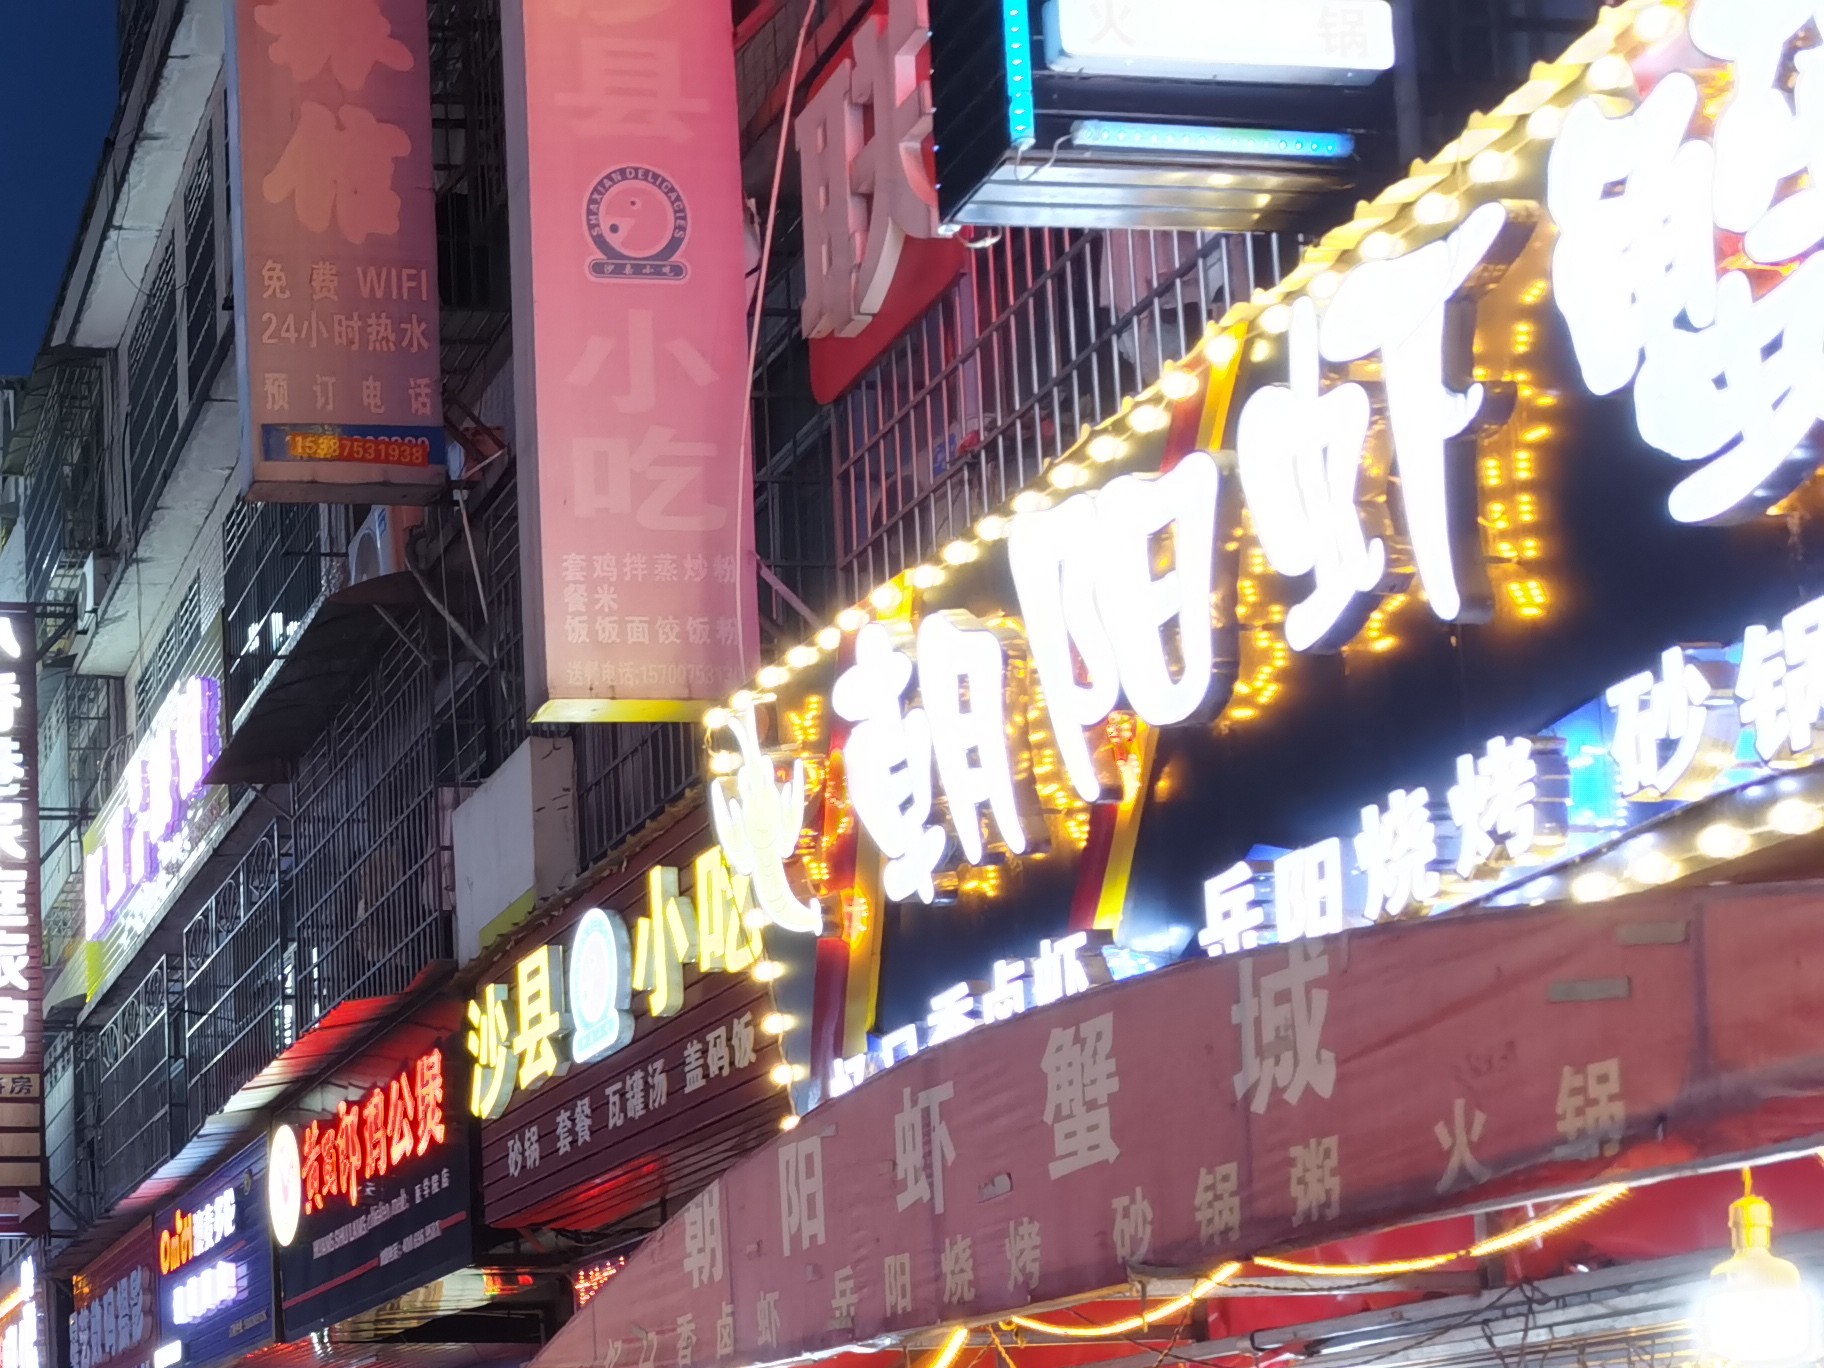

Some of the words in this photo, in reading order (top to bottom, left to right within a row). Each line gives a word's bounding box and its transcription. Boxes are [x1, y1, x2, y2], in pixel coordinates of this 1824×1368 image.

[262, 259, 339, 301] 免费
[356, 266, 427, 301] WIFI
[262, 310, 430, 353] 24小时热水
[264, 373, 431, 416] 预订电话
[565, 309, 731, 533] 小吃
[1198, 735, 1537, 957] 岳阳烧烤
[467, 944, 561, 1120] 沙县
[507, 1125, 540, 1177] 砂锅
[556, 1096, 592, 1155] 套餐
[604, 1058, 668, 1131] 瓦罐汤
[683, 1011, 757, 1094] 盖码饭
[682, 940, 1338, 1289] 朝阳虾蟹城
[831, 1216, 1042, 1318] 岳阳烧烤
[1113, 1134, 1341, 1262] 砂锅粥
[1434, 1058, 1627, 1196] 火锅
